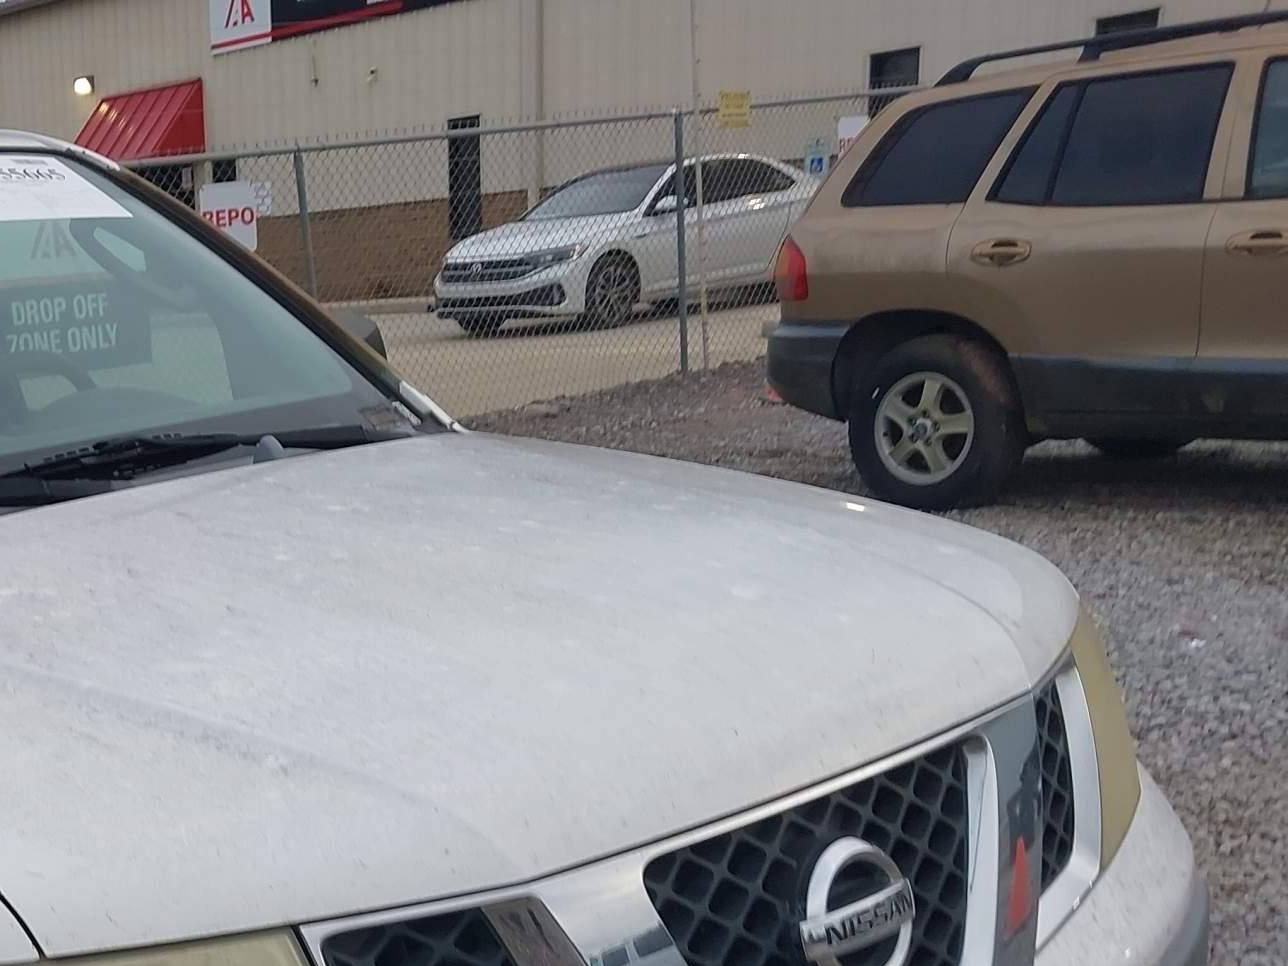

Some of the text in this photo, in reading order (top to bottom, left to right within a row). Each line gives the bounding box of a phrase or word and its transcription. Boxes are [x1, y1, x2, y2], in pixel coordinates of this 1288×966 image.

[11, 292, 108, 326] DROP OFF
[67, 322, 118, 352] ONLY
[824, 891, 912, 945] NISSAN
